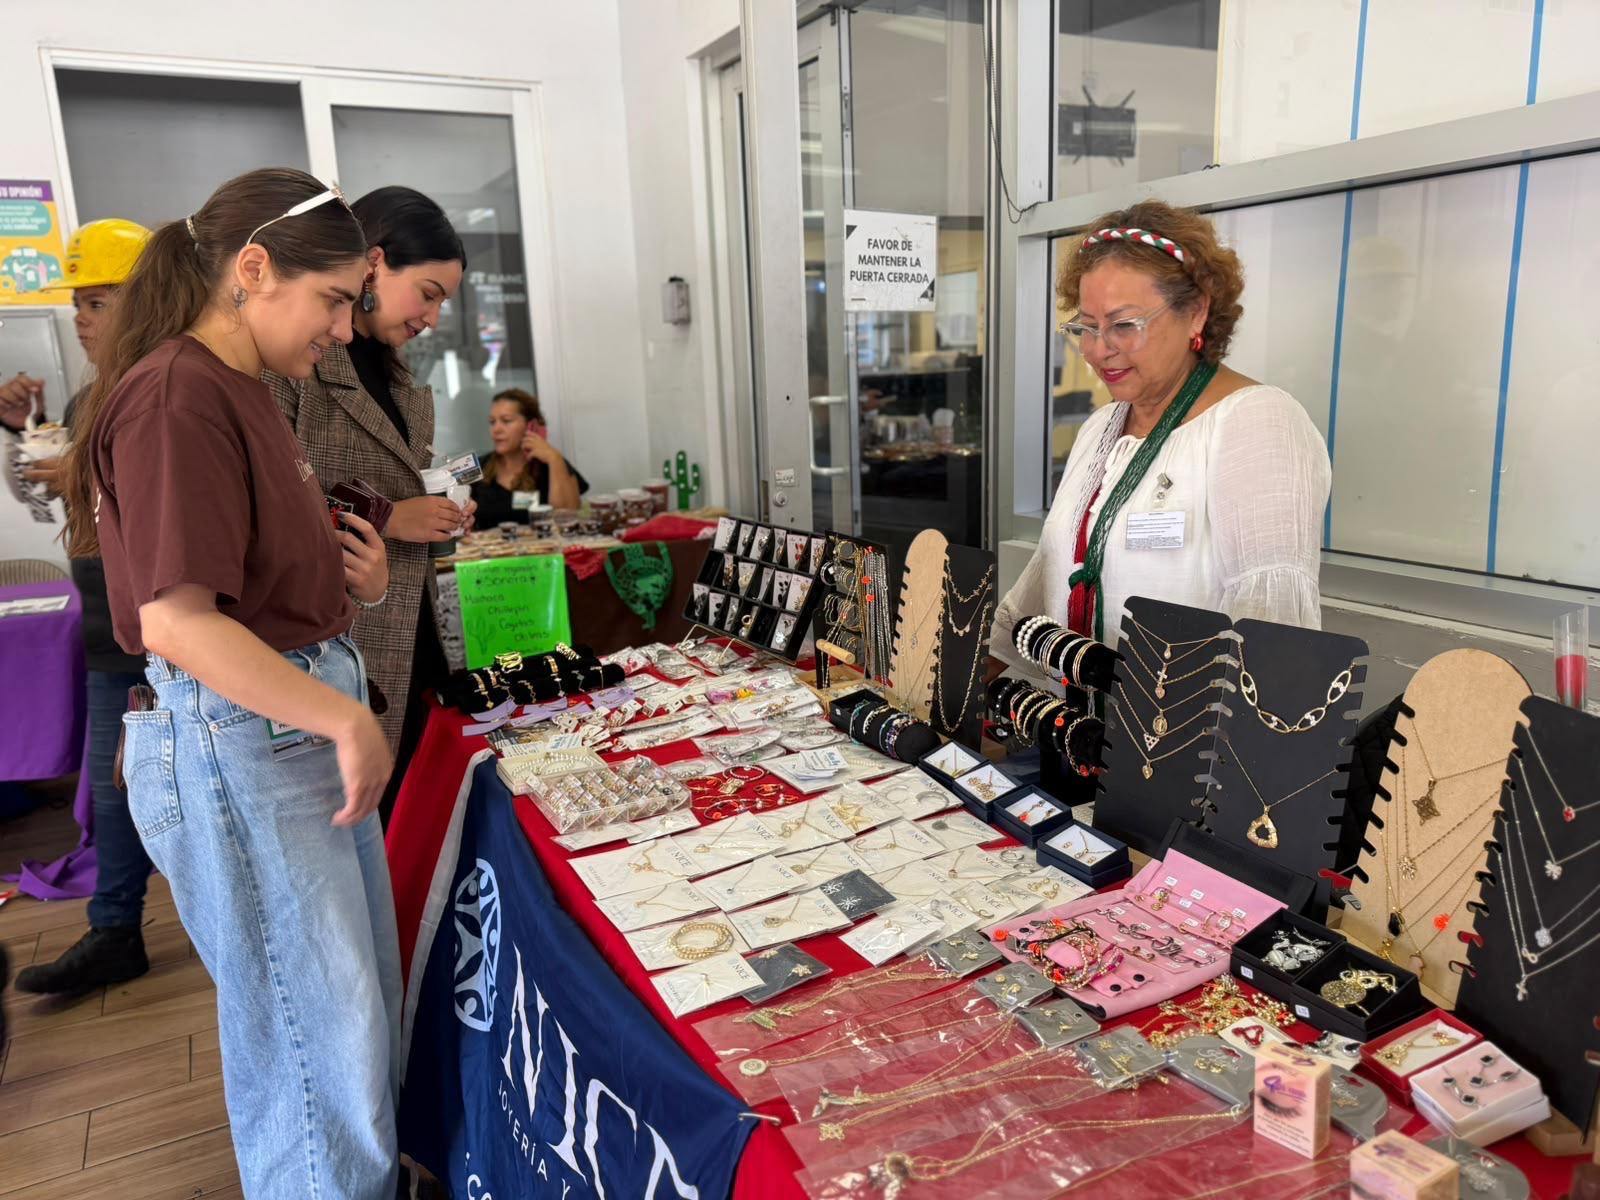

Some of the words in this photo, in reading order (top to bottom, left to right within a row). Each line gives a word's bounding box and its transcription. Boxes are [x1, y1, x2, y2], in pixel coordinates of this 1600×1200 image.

[867, 238, 900, 251] FAVOR
[901, 240, 913, 251] DE
[858, 254, 908, 267] MANTENER
[910, 257, 922, 268] LA
[850, 270, 886, 283] PUERTA
[887, 272, 930, 284] CERRADA
[755, 824, 774, 841] NICE
[676, 850, 693, 868] NICE
[982, 895, 1004, 909] NICE
[947, 903, 967, 918] NICE
[912, 912, 932, 926] NICE
[733, 964, 751, 980] NICE
